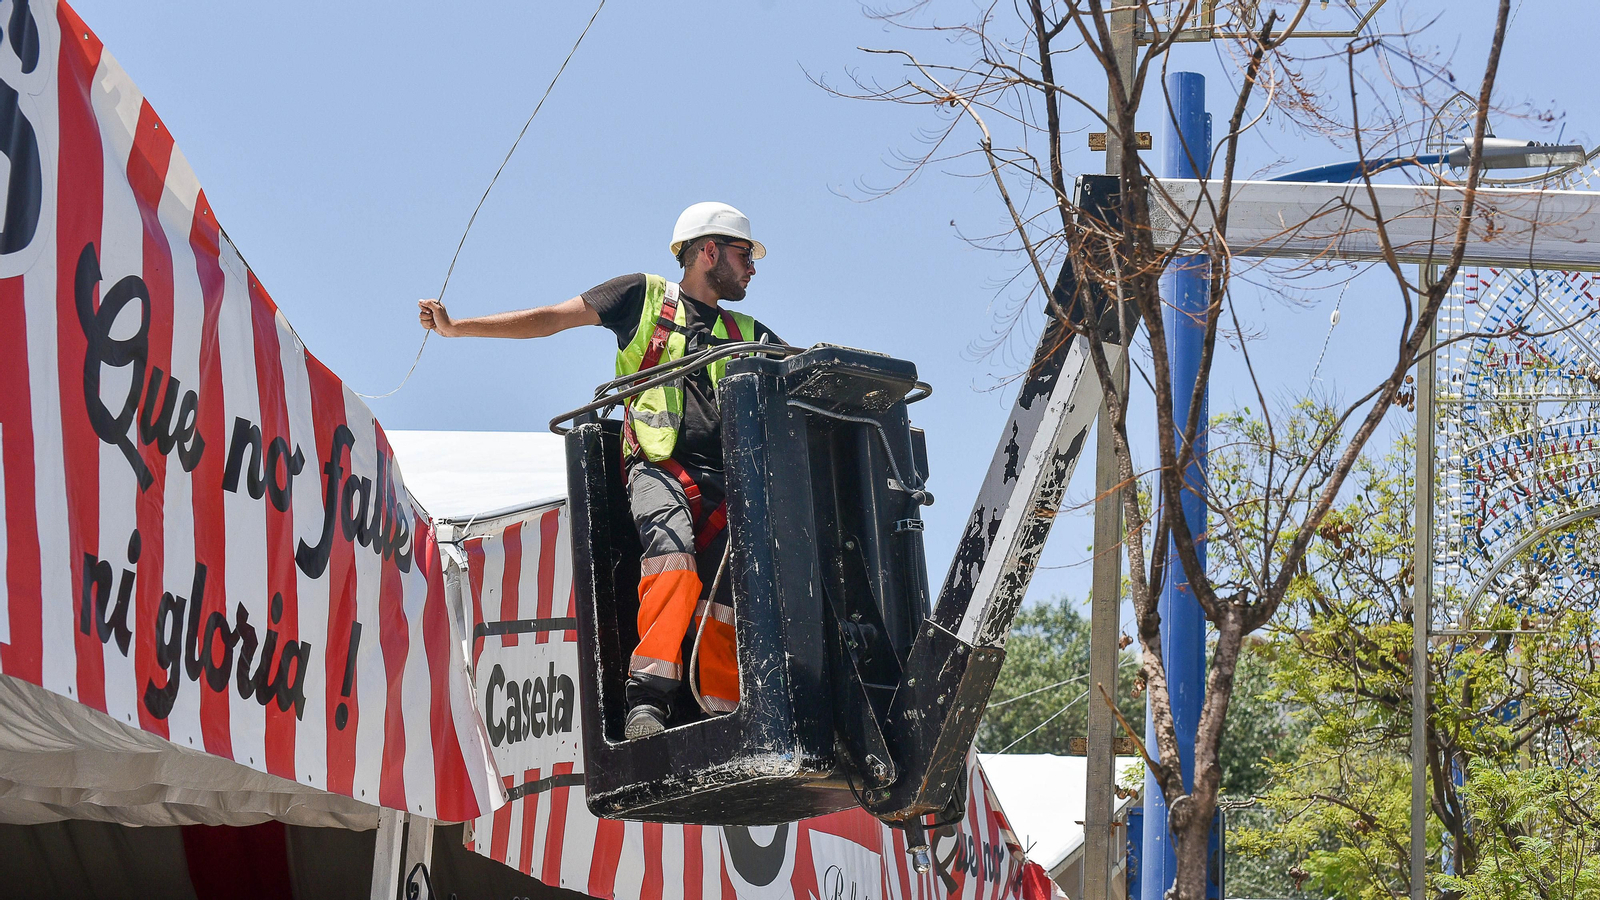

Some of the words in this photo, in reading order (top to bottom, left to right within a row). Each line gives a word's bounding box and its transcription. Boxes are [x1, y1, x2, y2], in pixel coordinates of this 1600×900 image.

[74, 241, 205, 493] Que
[222, 416, 304, 512] no
[295, 424, 413, 579] falte
[80, 528, 142, 657] ni
[144, 561, 312, 720] gloria
[485, 662, 575, 748] Caseta
[983, 841, 1004, 885] no
